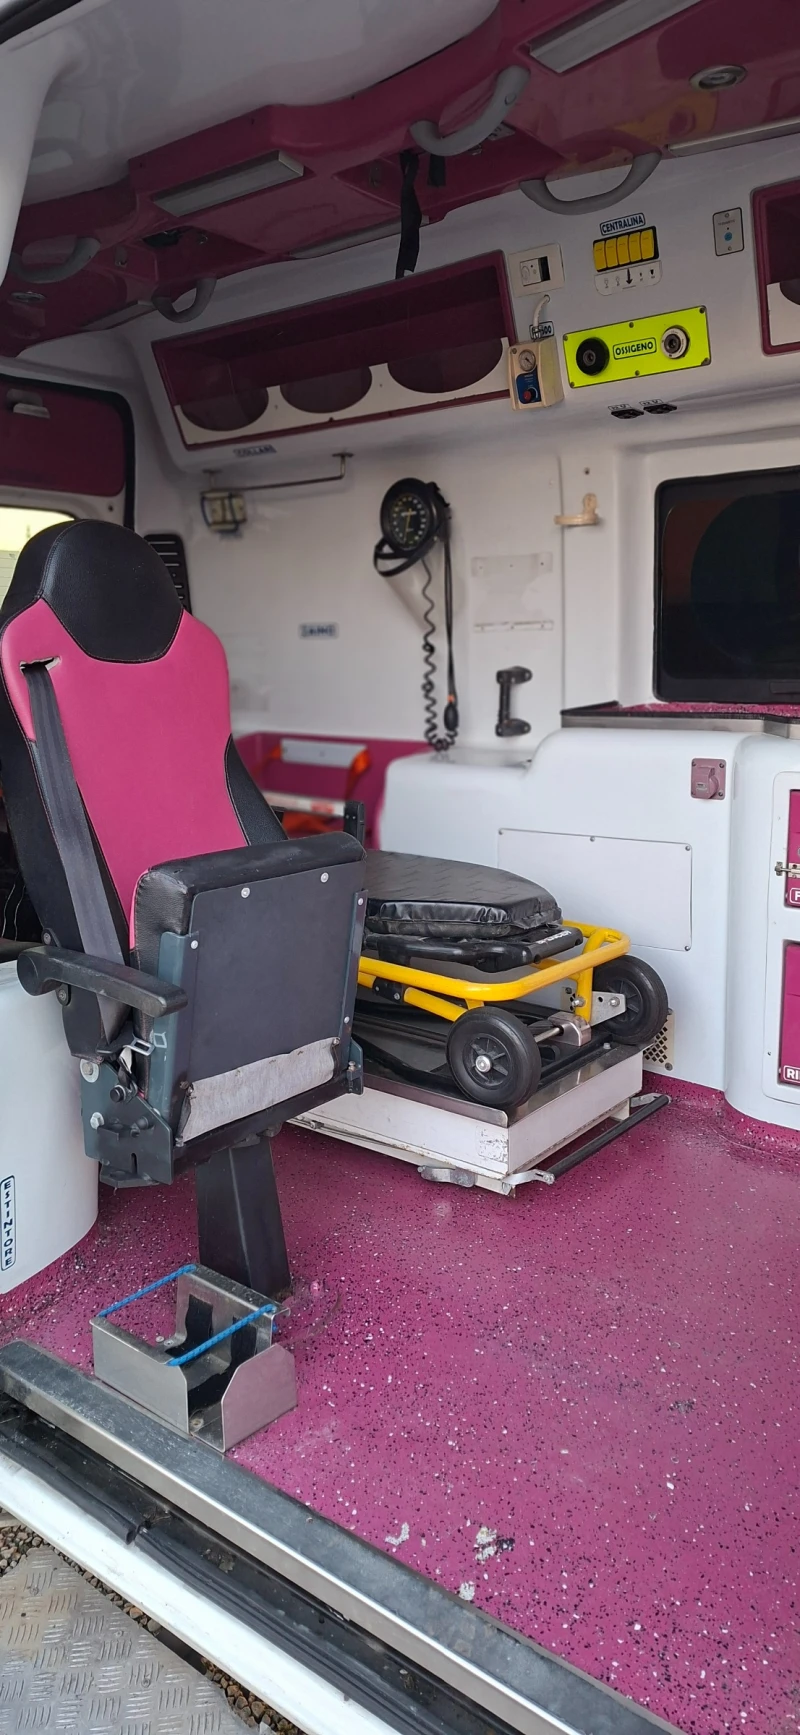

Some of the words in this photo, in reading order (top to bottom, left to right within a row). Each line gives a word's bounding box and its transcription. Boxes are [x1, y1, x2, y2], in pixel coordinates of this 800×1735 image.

[601, 215, 644, 233] CENTRALINA
[615, 341, 654, 356] OSSIGENO
[3, 1180, 14, 1267] ESTINTORE
